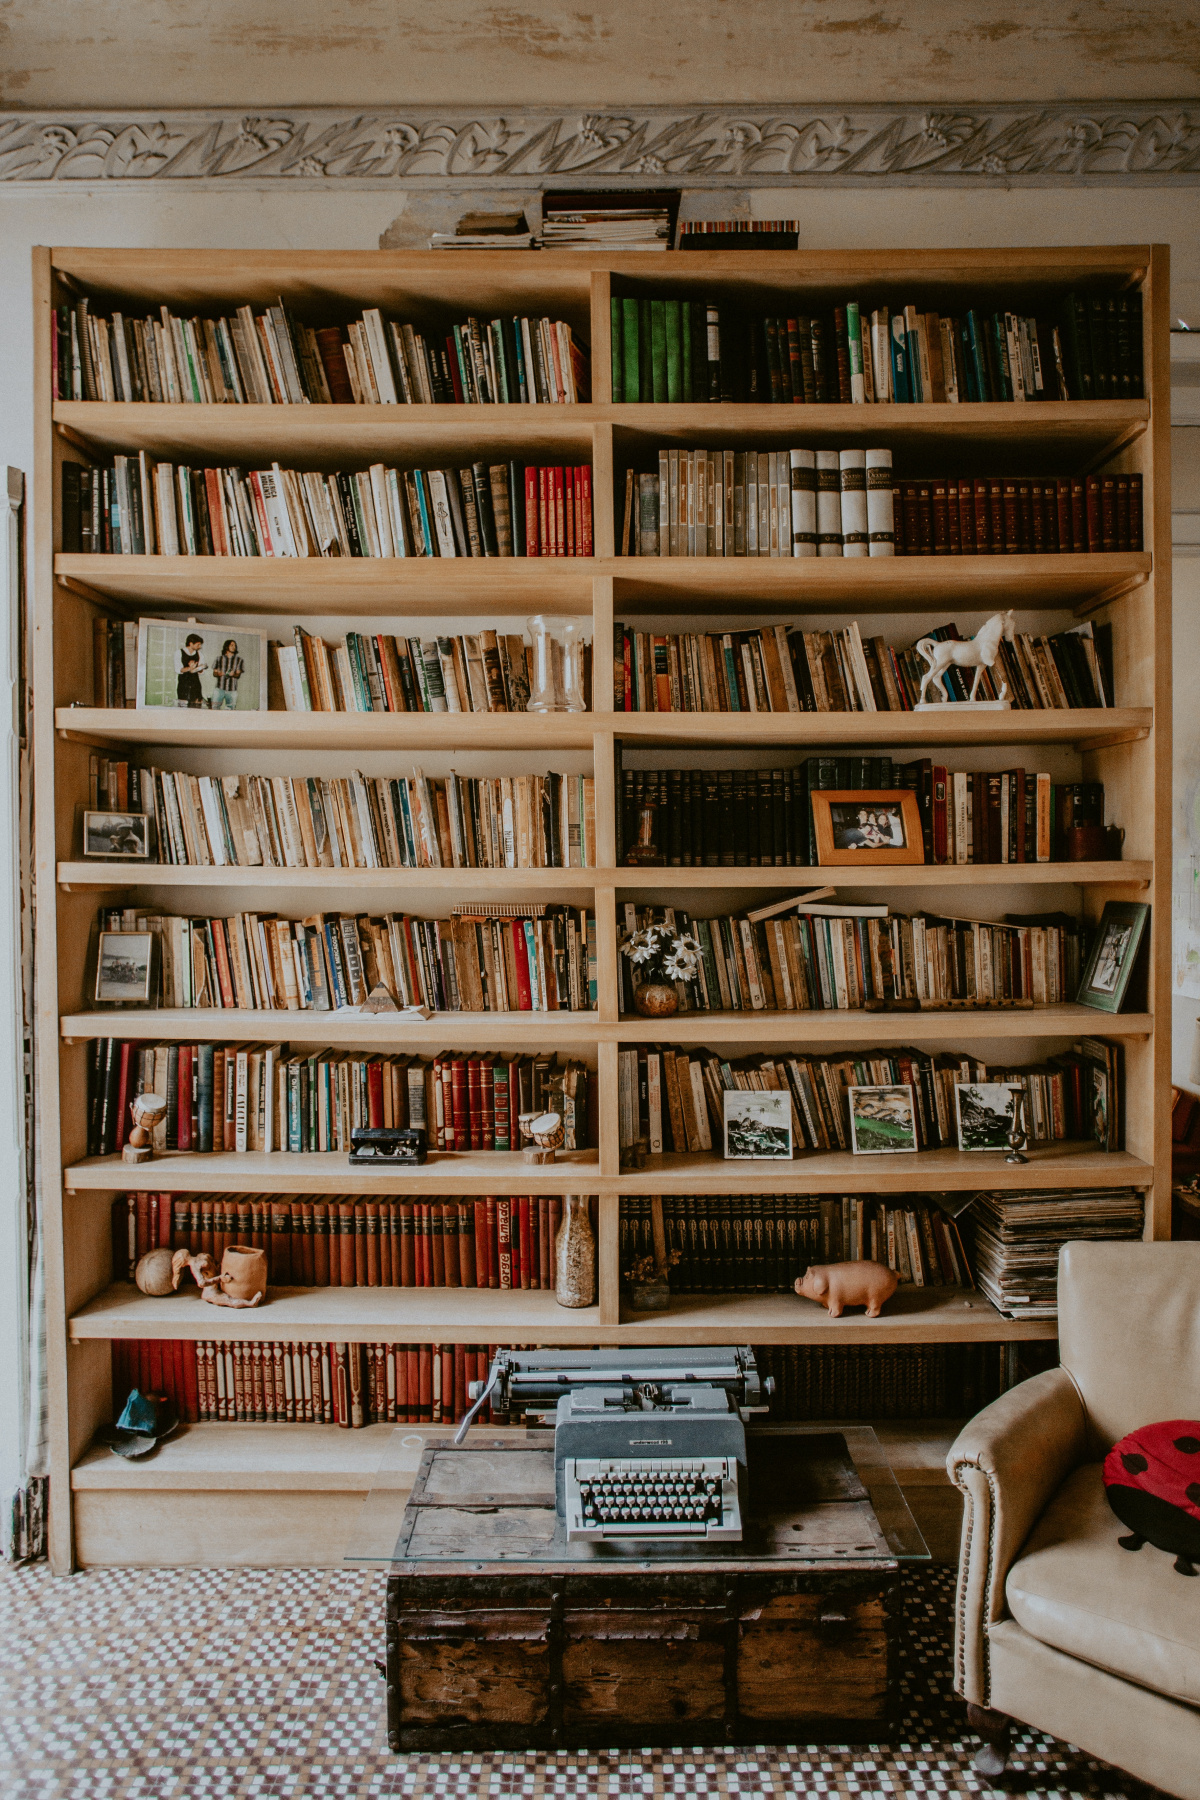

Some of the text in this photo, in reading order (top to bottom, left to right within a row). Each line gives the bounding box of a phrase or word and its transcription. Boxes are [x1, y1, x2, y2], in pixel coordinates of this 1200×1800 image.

[261, 475, 271, 500] VIOLENTA
[268, 475, 277, 498] AMERICA
[445, 1082, 453, 1127] CURIOSIDADES
[499, 1202, 509, 1242] amado
